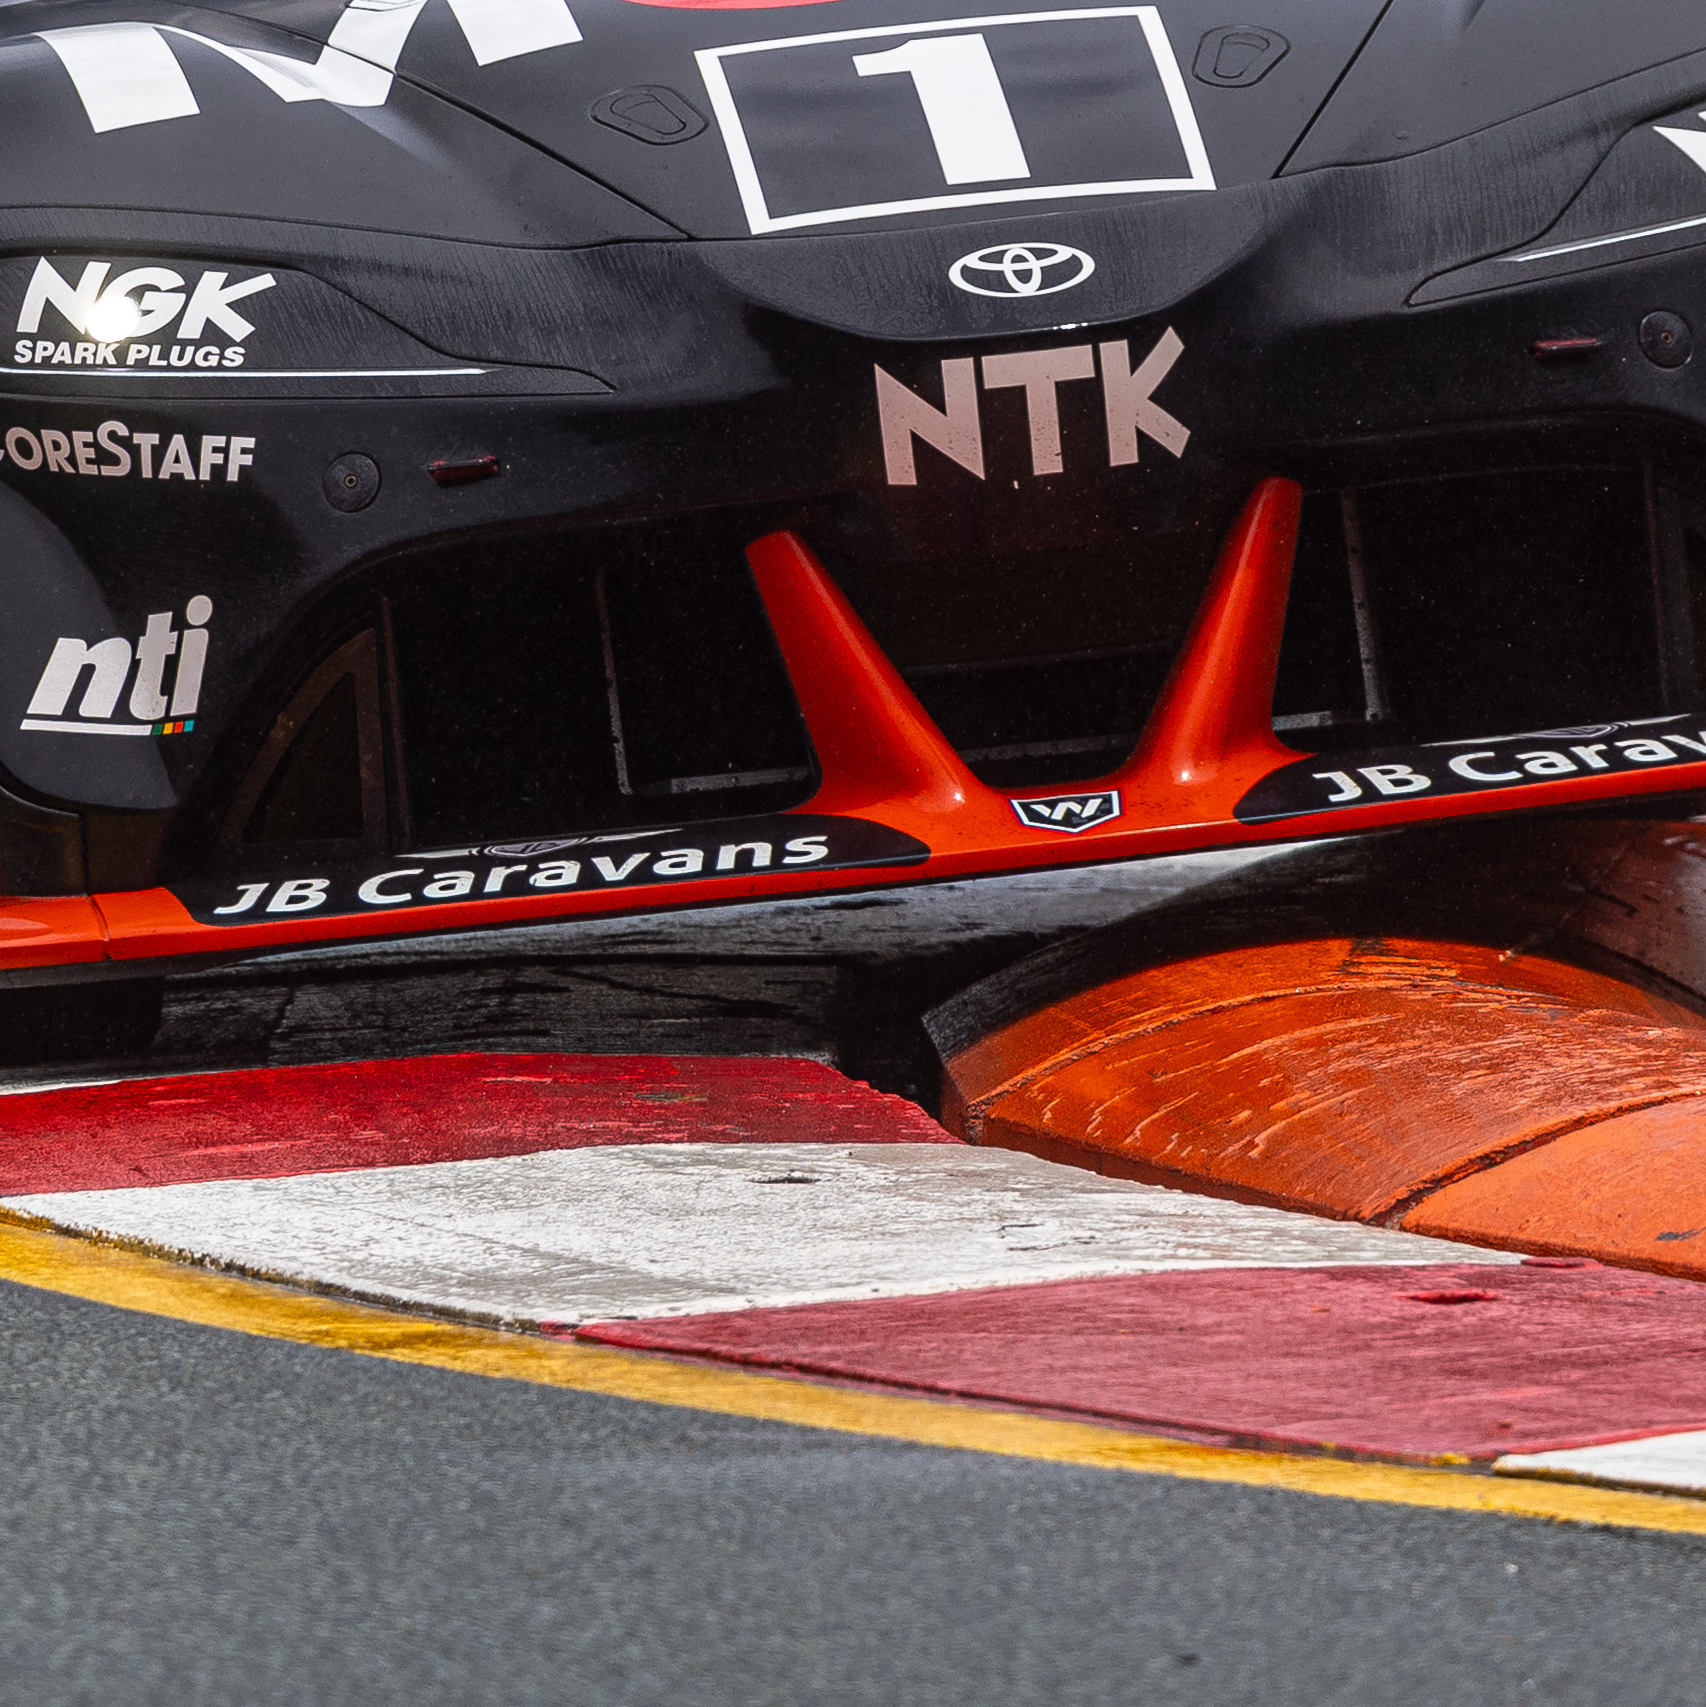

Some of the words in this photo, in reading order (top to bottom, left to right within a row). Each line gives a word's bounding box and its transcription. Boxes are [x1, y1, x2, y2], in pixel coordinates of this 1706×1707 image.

[852, 33, 1031, 186] 1
[16, 256, 277, 342] NGK
[13, 339, 117, 365] SPARK
[126, 342, 246, 367] PLUGS
[874, 326, 1191, 485] NTK
[26, 595, 213, 719] nti
[1312, 764, 1431, 803] JB
[213, 879, 329, 916] JB
[357, 833, 831, 905] Caravans
